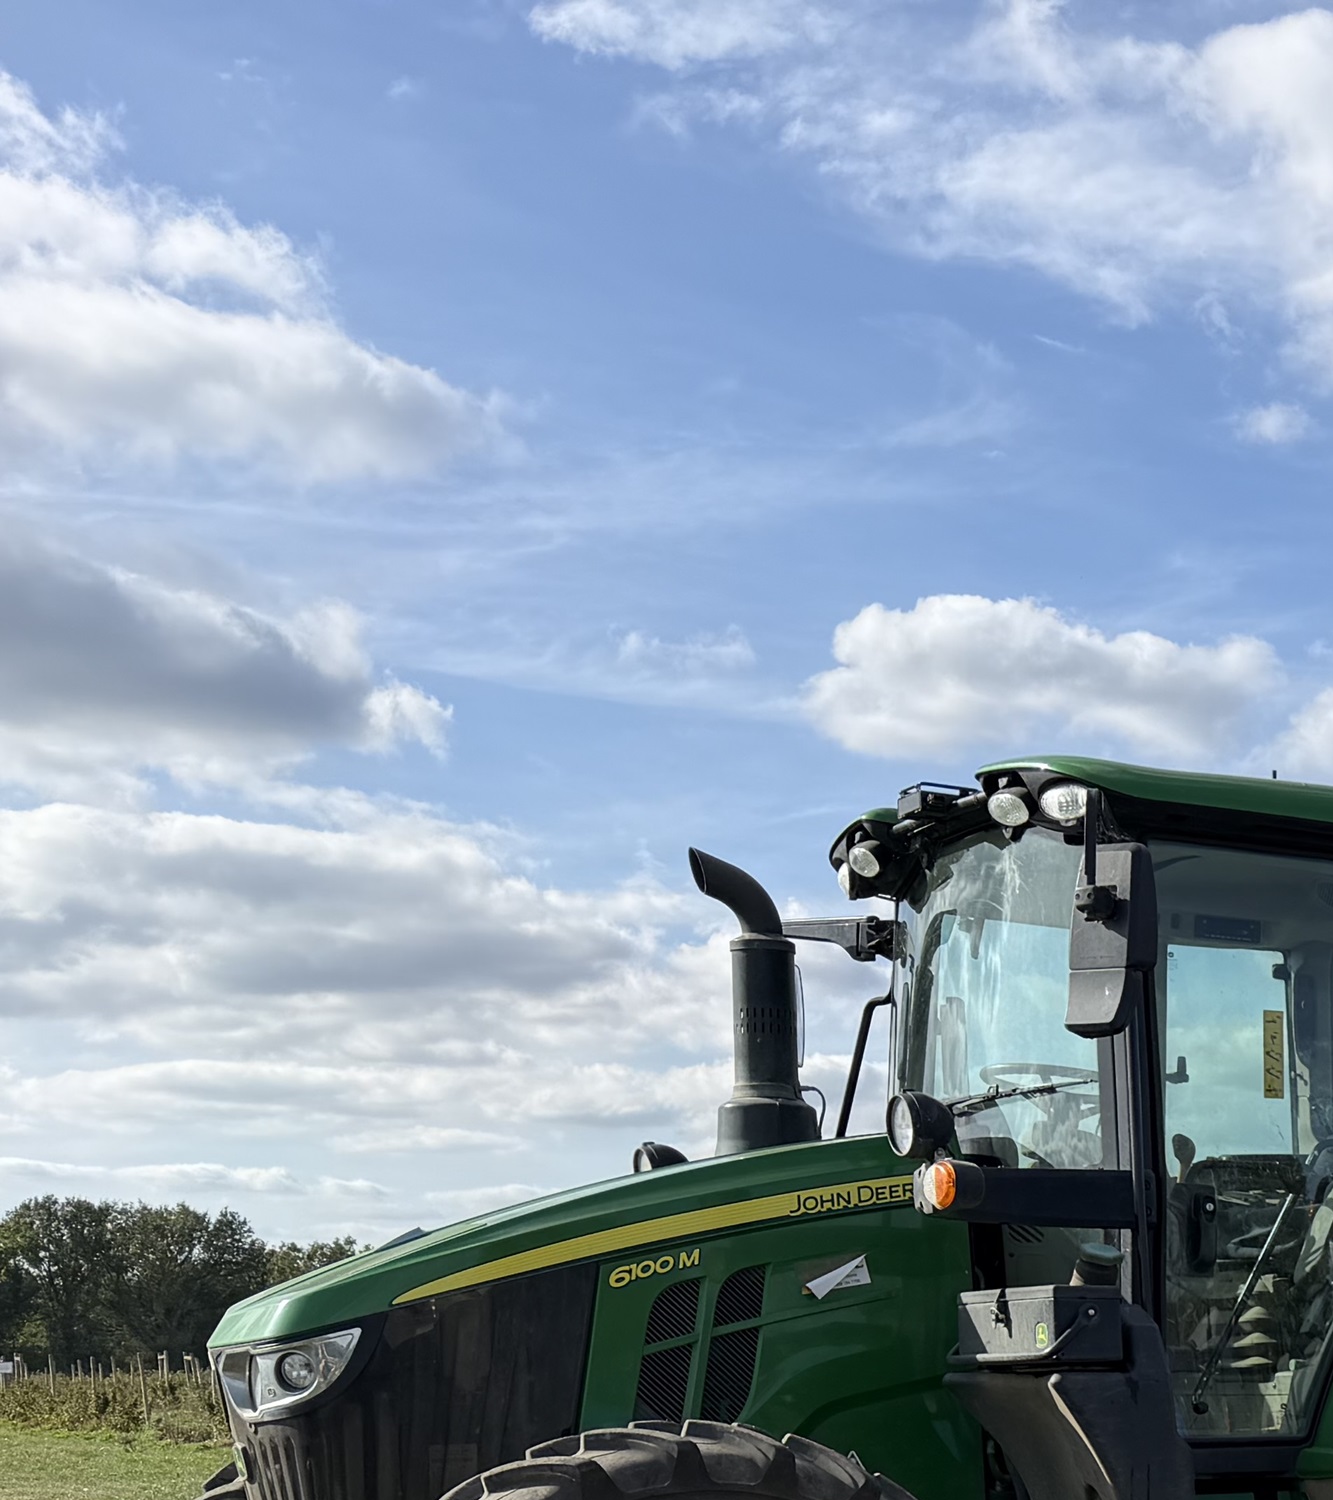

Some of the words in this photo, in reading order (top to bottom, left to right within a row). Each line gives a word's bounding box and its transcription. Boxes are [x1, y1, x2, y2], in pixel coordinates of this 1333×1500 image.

[789, 1190, 851, 1214] JOHN
[857, 1183, 914, 1204] DEER
[608, 1255, 675, 1288] 6100
[678, 1248, 700, 1269] M
